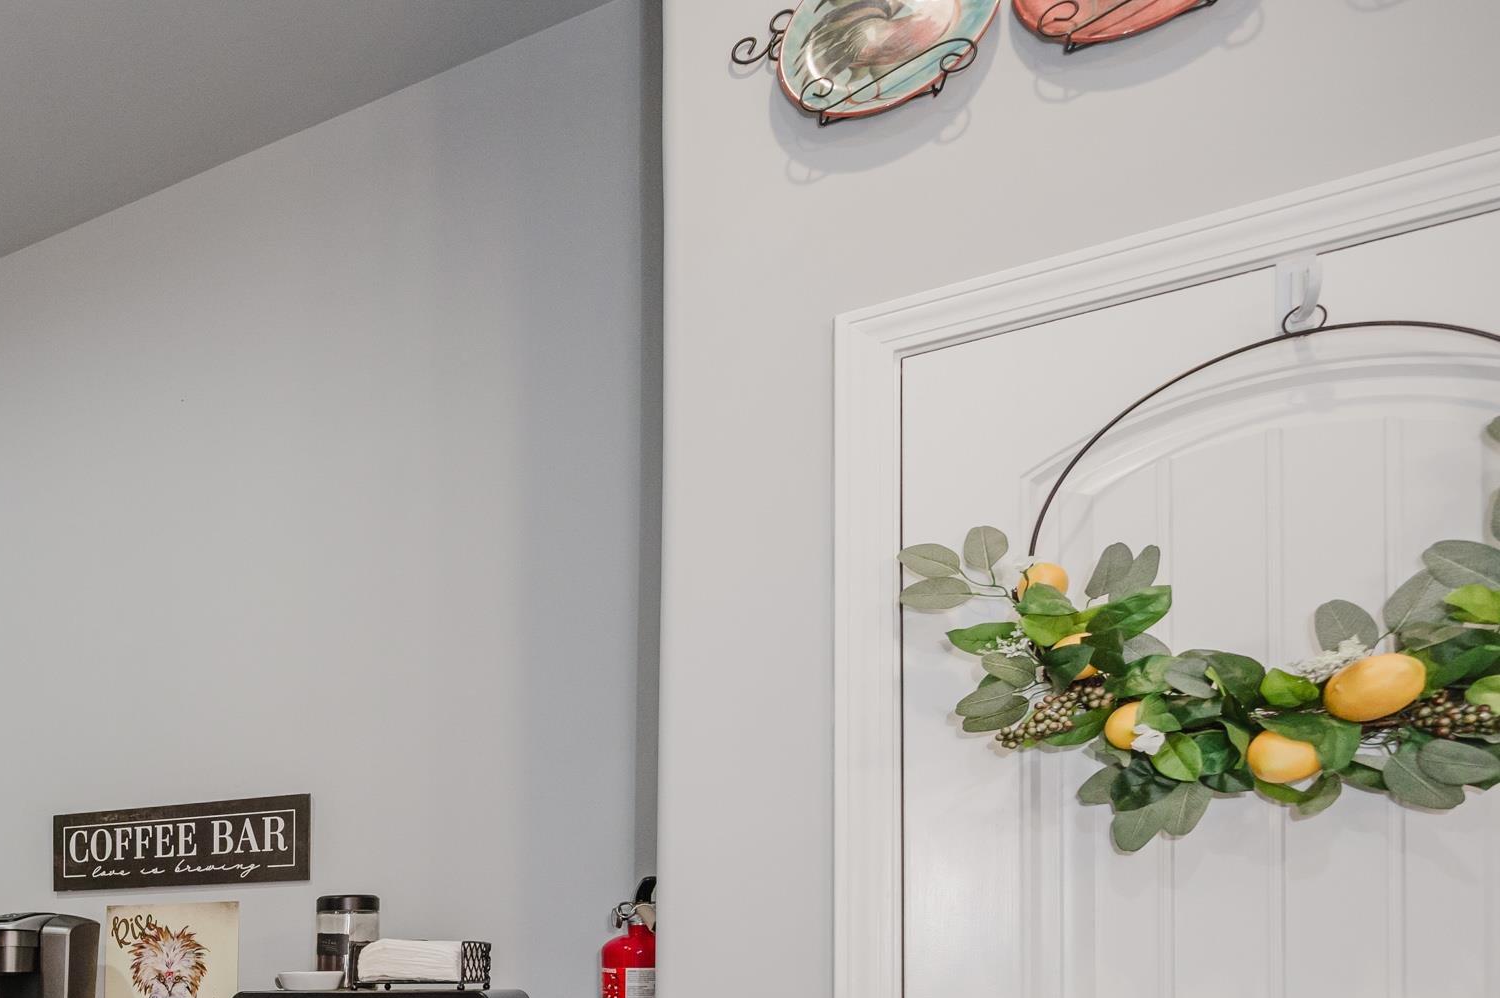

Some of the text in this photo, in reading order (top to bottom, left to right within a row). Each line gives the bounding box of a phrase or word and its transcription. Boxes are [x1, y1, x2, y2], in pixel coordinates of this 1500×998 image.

[69, 816, 288, 863] COFFEE BAR
[92, 859, 260, 878] love is brewing
[111, 913, 158, 949] Rise
